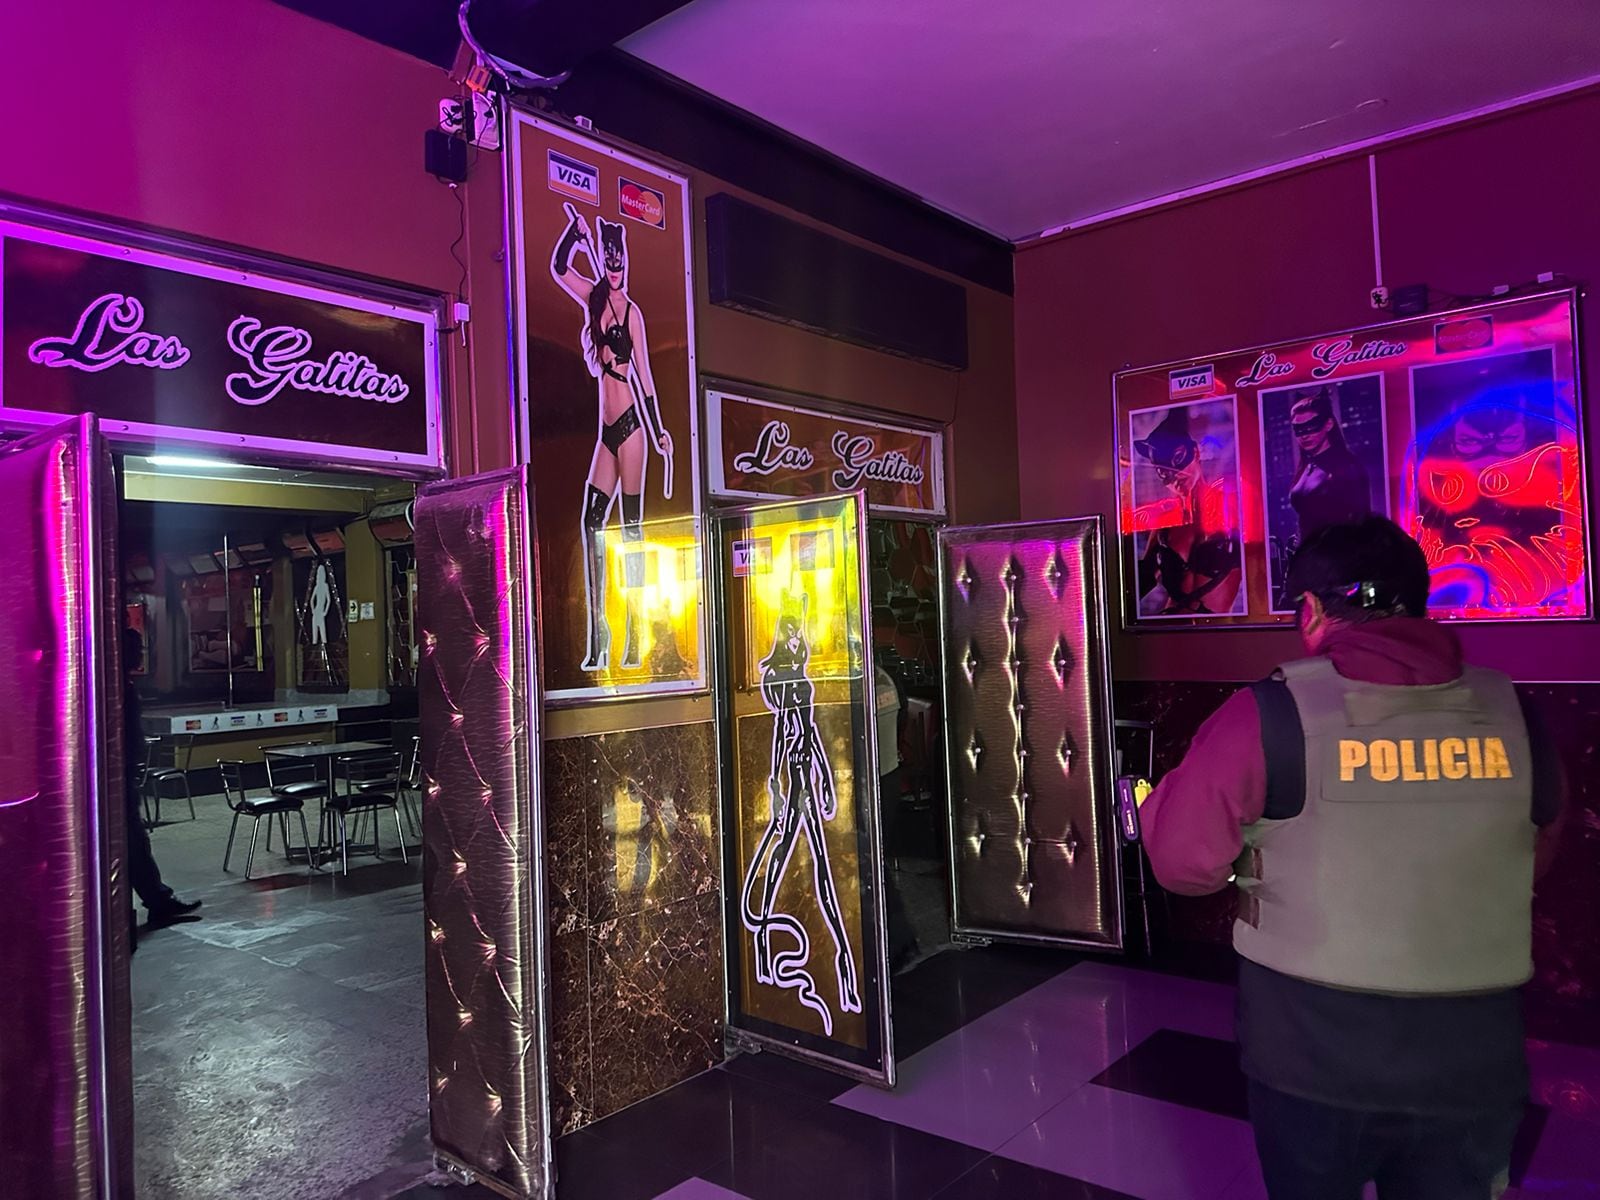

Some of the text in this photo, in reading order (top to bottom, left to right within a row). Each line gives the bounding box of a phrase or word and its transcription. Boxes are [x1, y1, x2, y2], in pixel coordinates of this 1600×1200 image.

[557, 167, 591, 191] VISA
[621, 193, 660, 216] MasterCard
[28, 293, 410, 406] Las Gatitas
[1235, 340, 1408, 388] Las Gatitas
[1178, 374, 1207, 389] VISA
[734, 420, 924, 491] Las Gatitas
[1338, 736, 1513, 782] POLICIA
